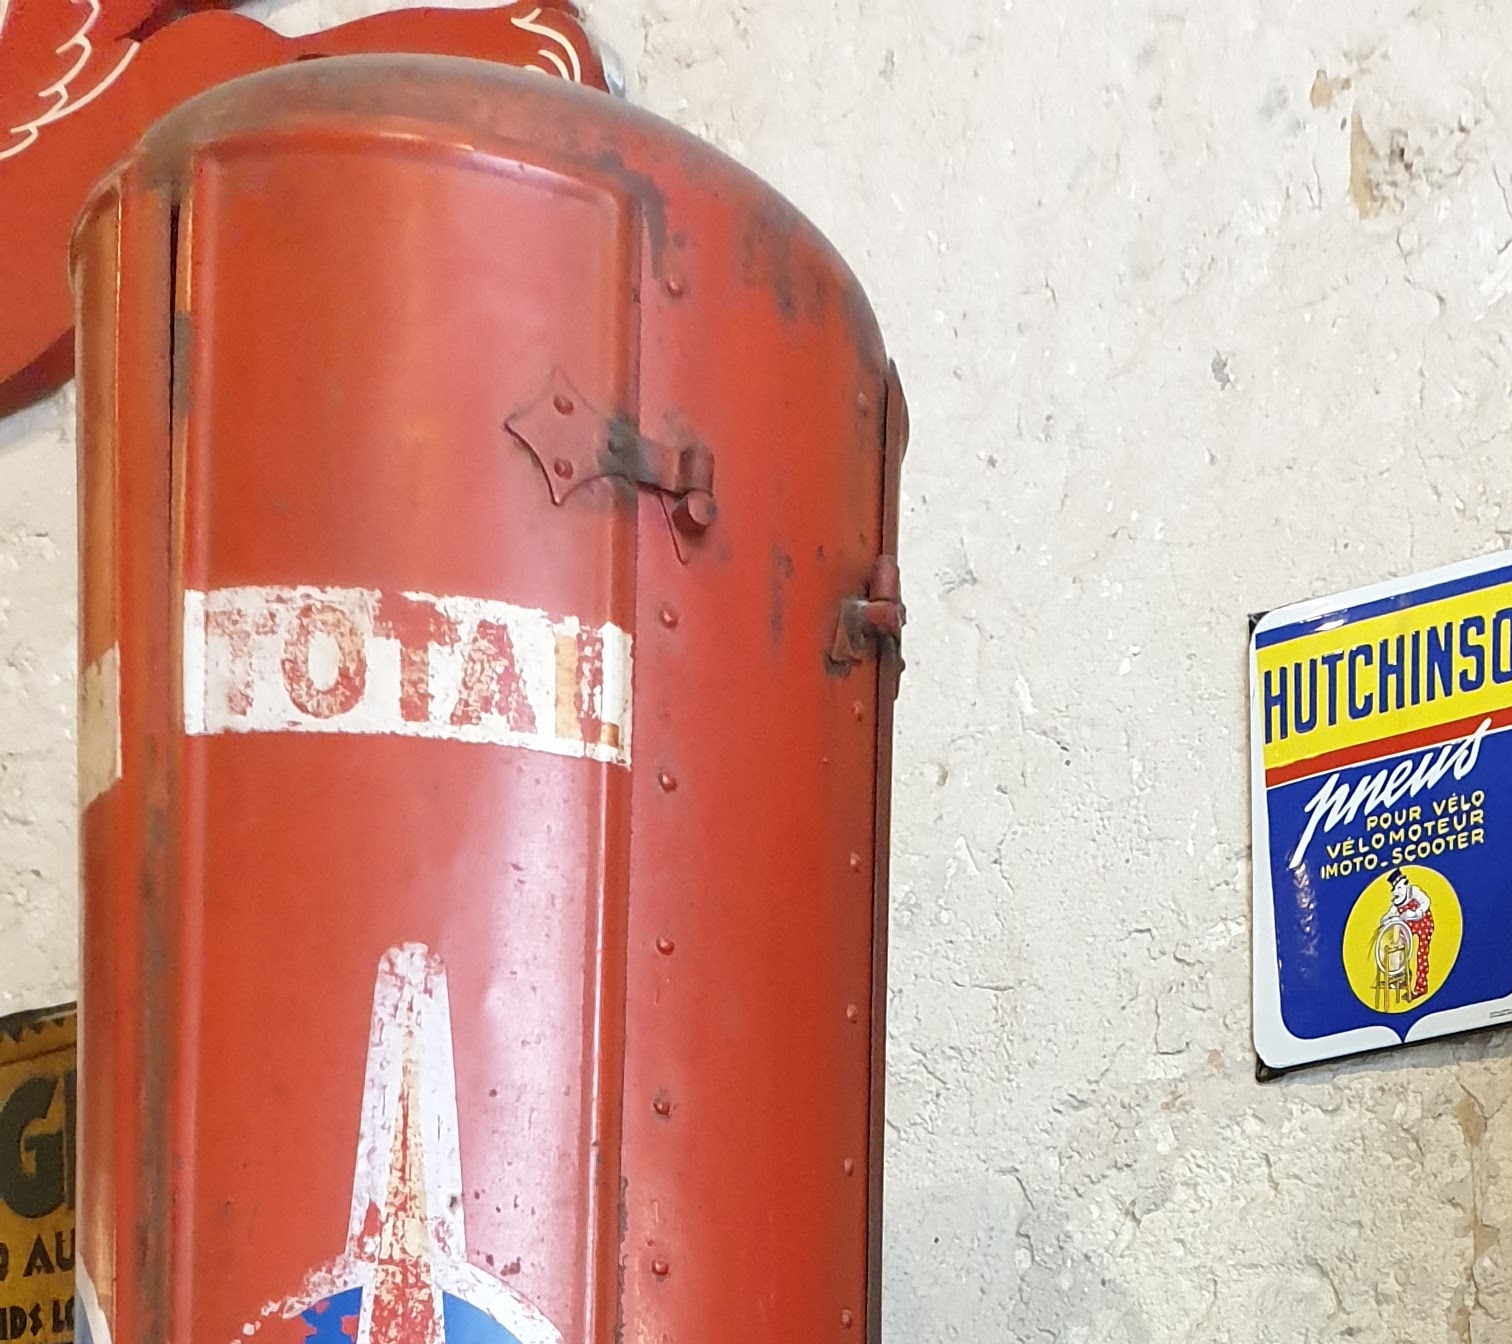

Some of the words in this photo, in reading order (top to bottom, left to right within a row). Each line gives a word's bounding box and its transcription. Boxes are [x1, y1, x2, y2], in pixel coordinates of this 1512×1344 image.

[1289, 718, 1492, 869] pneus
[1366, 805, 1421, 832] POUR
[1432, 790, 1485, 815] VÉLO
[1325, 809, 1485, 860] VÉLOMOTEUR
